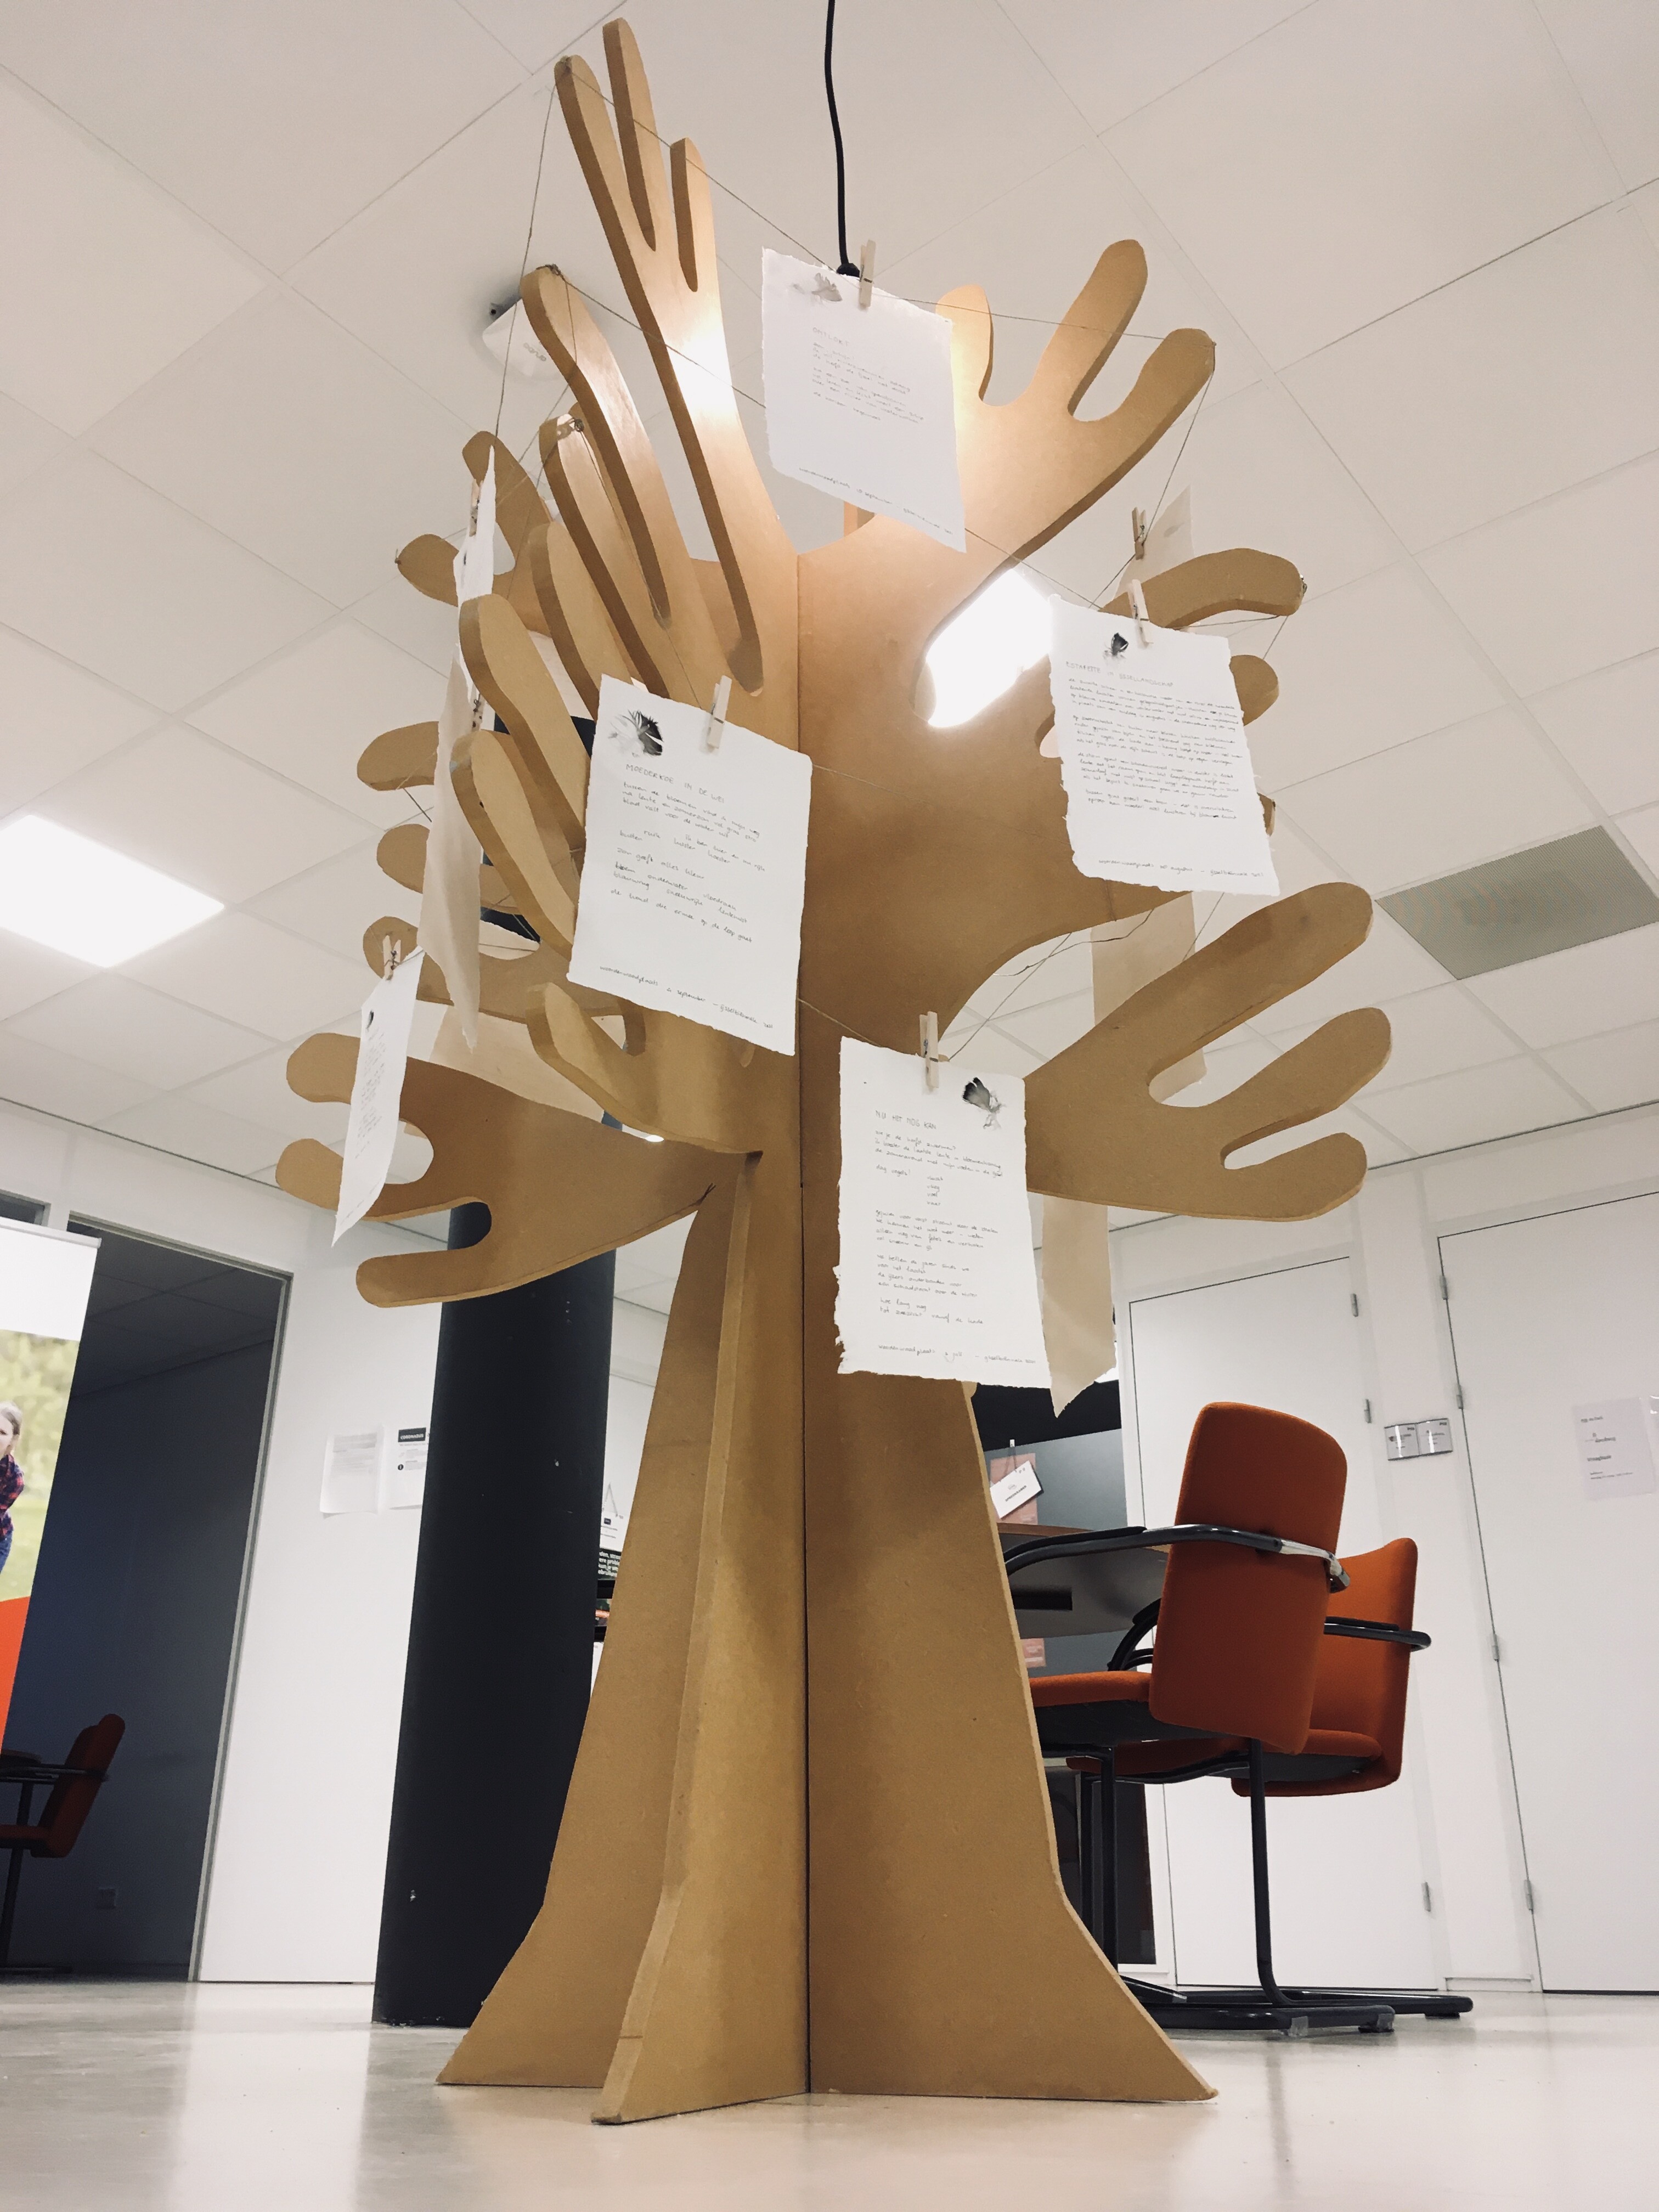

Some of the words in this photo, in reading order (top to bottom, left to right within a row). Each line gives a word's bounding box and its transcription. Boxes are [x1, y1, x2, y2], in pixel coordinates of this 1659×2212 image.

[625, 764, 673, 783] MOEDERKOE
[699, 787, 707, 795] DE
[710, 793, 724, 803] WEI
[623, 781, 646, 792] tussen
[666, 793, 696, 809] bloemen
[638, 793, 656, 803] lente
[674, 806, 709, 822] zomerzon
[695, 823, 714, 831] winter
[619, 830, 642, 840] buiten
[713, 845, 726, 853] hier
[635, 854, 653, 864] geeft
[661, 861, 678, 871] alles
[685, 868, 704, 878] kleur
[647, 874, 687, 890] onderwater
[674, 910, 694, 919] ermee
[723, 926, 735, 936] loop
[737, 934, 752, 943] gaat
[677, 990, 706, 1001] september
[875, 1110, 886, 1119] NU
[886, 1150, 922, 1161] zomeravond
[876, 1164, 887, 1173] dag
[896, 1298, 910, 1308] lang
